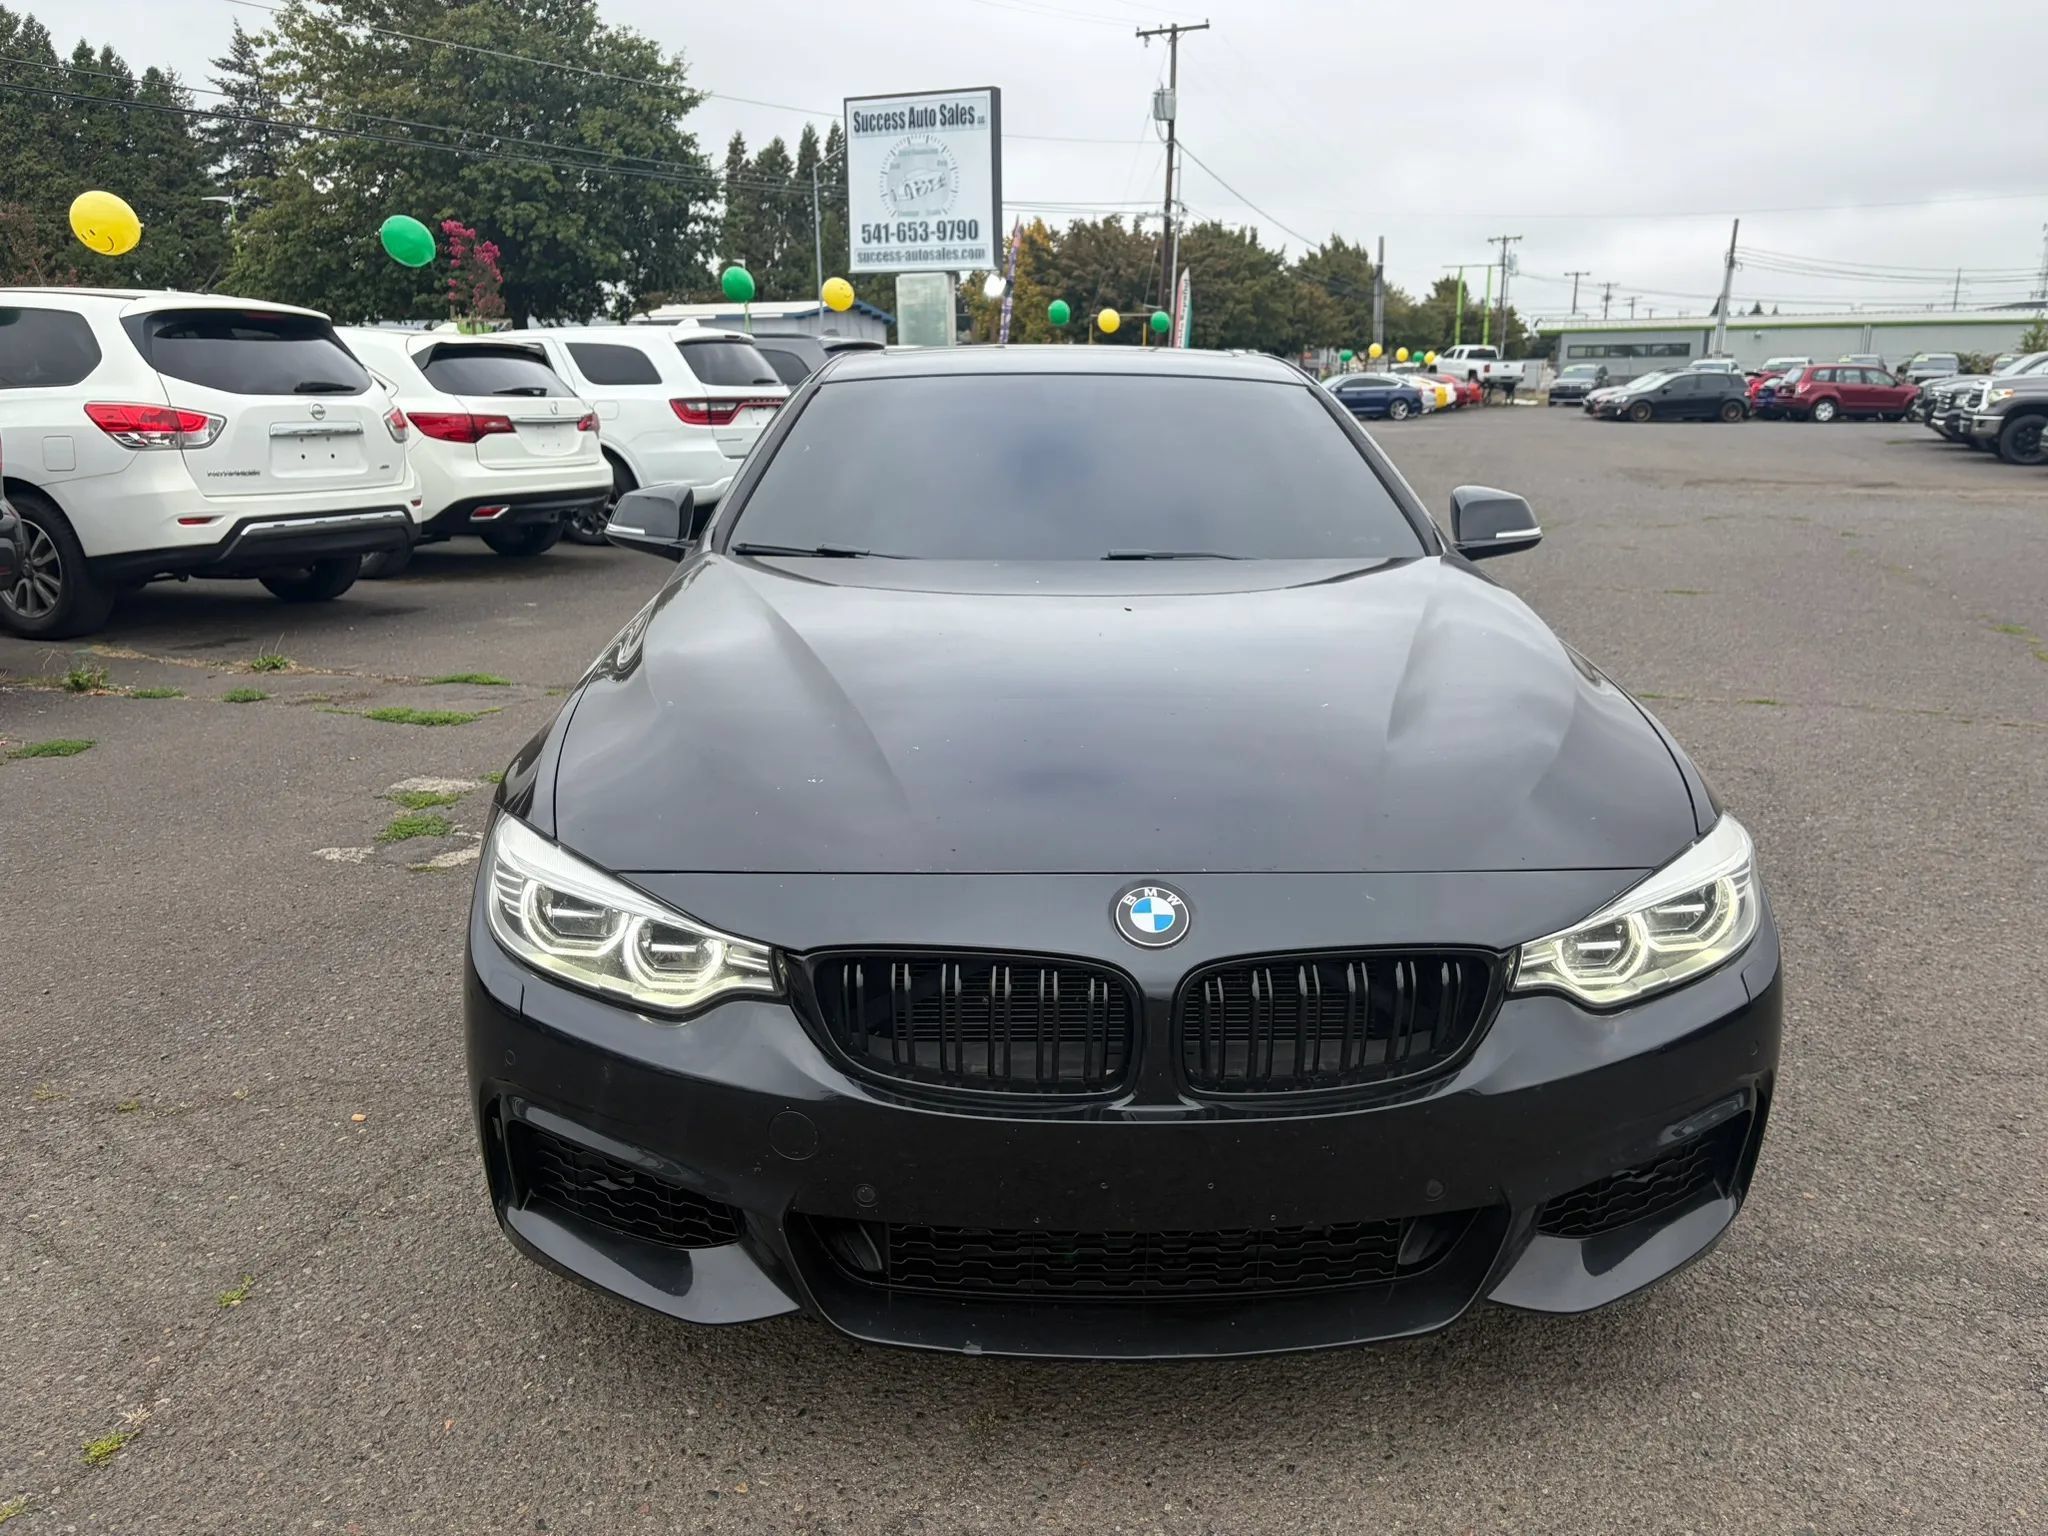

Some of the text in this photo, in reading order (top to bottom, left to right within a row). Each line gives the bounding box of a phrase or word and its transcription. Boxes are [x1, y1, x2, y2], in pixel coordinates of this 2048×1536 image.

[853, 103, 976, 133] Success Auto Sales
[861, 219, 979, 245] 541-653-9790
[857, 247, 986, 264] success-autosales.com
[1123, 887, 1182, 906] BMW
